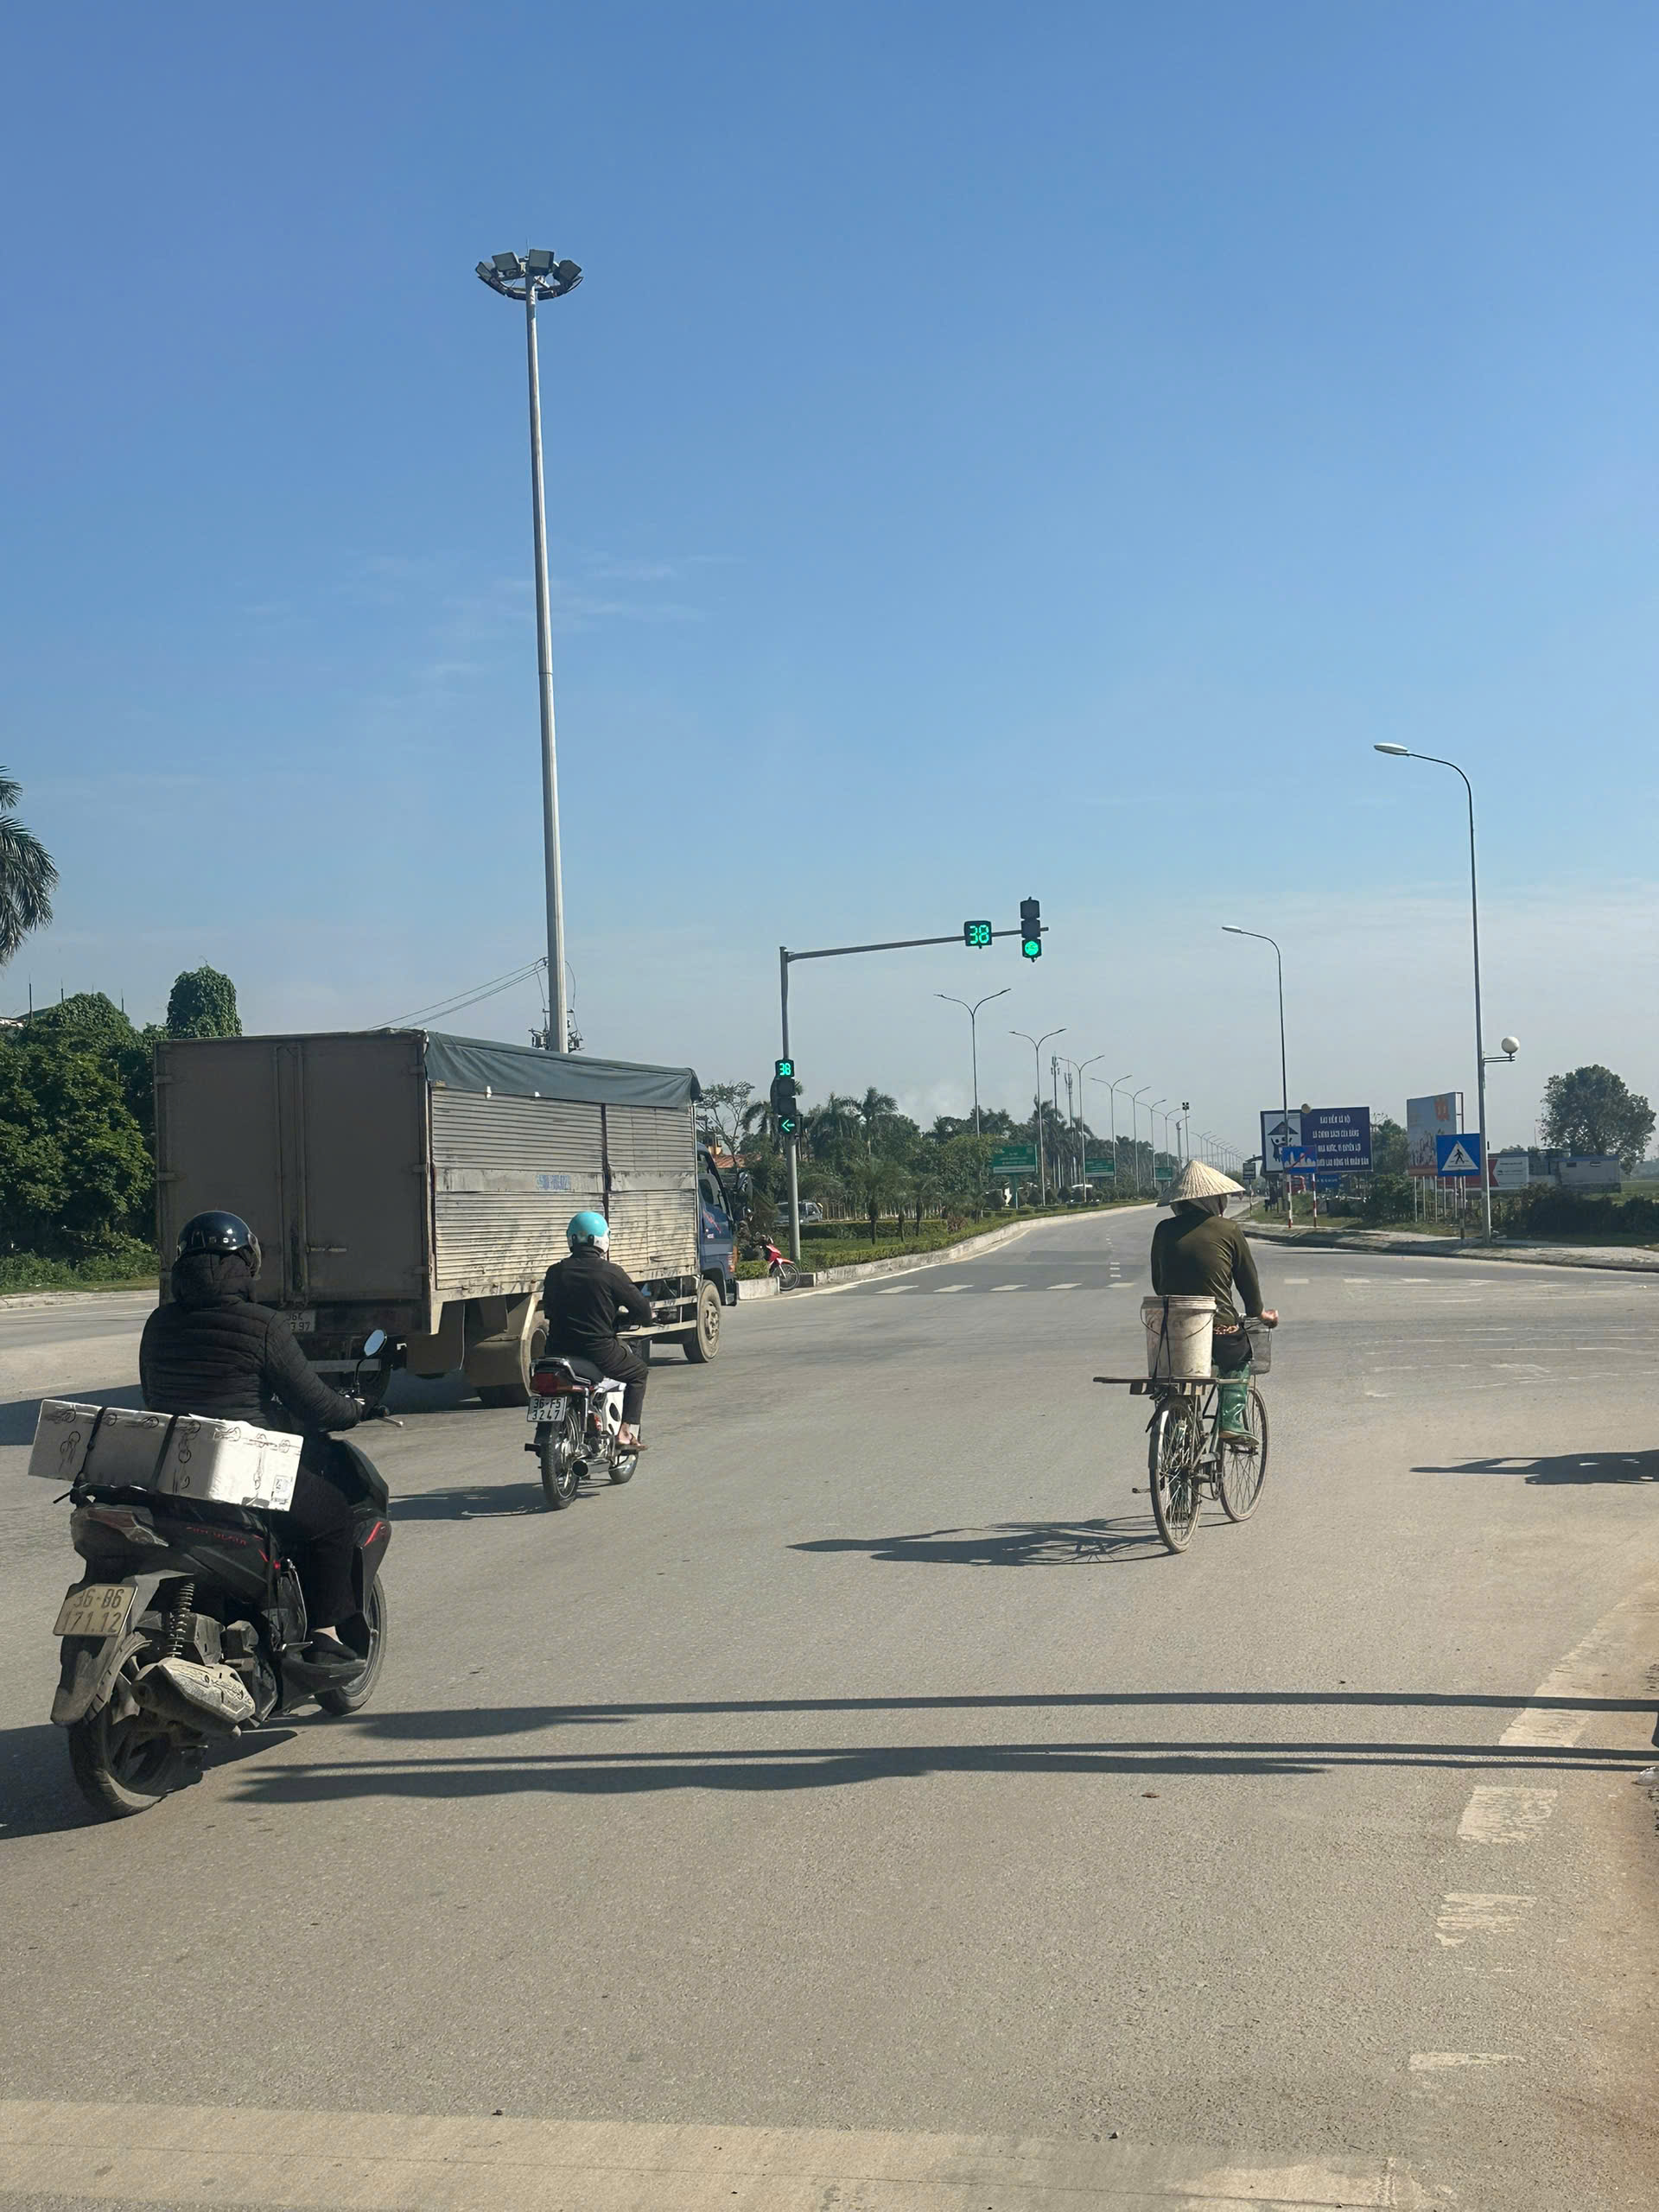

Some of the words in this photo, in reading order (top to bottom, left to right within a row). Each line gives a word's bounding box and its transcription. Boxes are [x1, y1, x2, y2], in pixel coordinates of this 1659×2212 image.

[969, 925, 989, 944] 38
[779, 1062, 791, 1076] 38
[533, 1398, 562, 1408] 36-F5
[532, 1409, 561, 1420] 3247
[73, 1588, 124, 1609] 36-B6
[61, 1611, 122, 1634] 171.12
